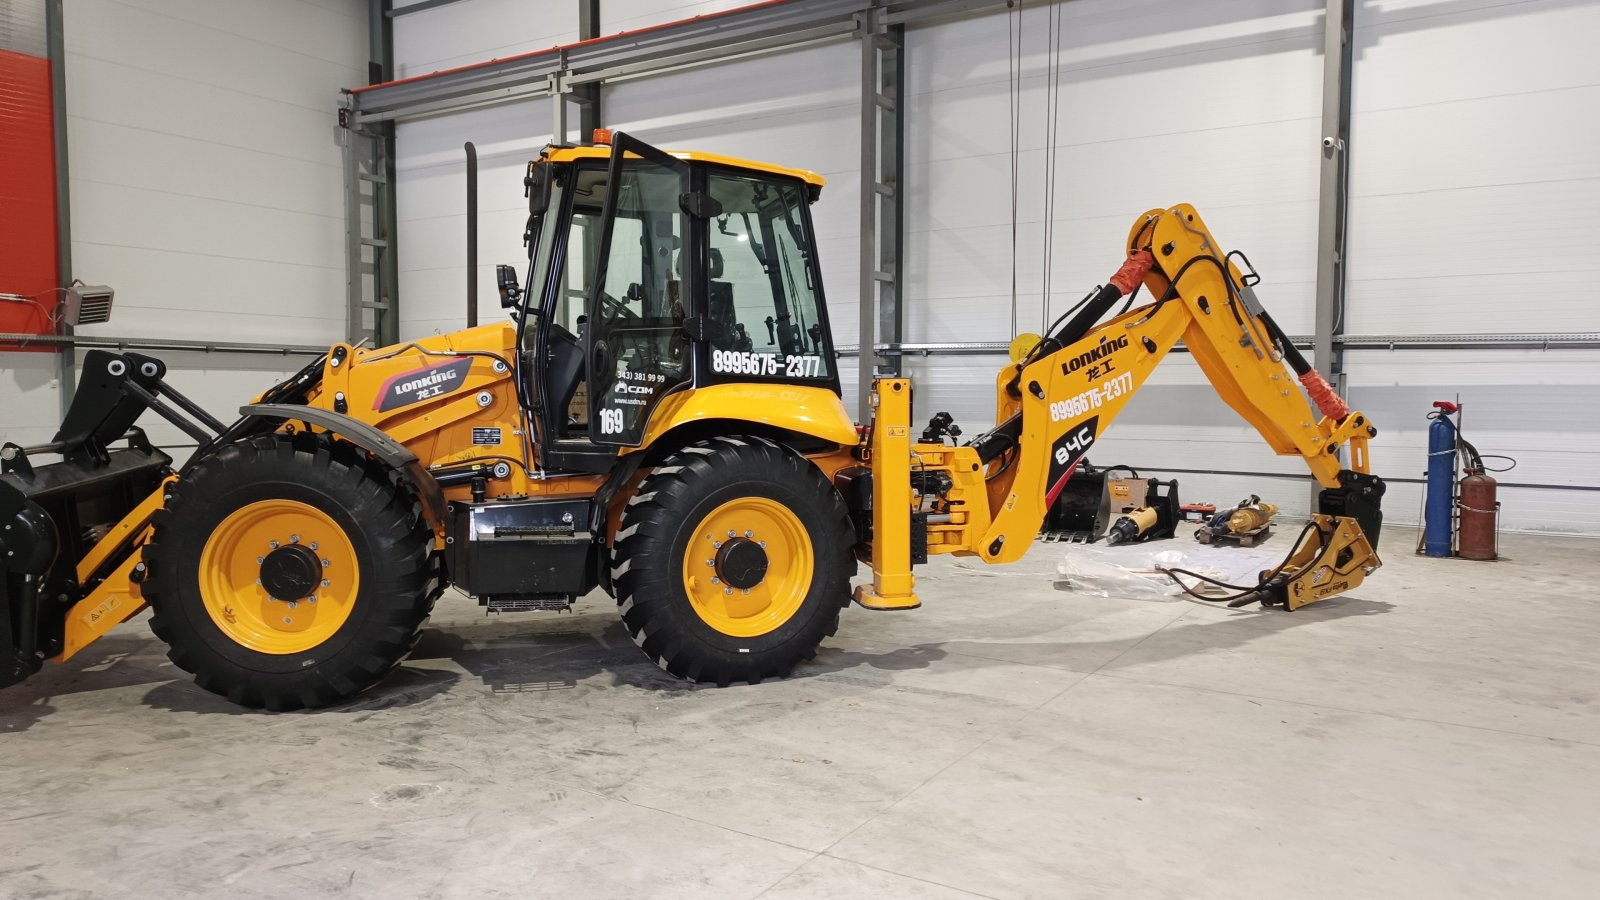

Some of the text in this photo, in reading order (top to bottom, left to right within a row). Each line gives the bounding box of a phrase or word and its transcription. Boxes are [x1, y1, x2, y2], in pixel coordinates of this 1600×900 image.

[713, 349, 820, 378] 8995675-2377
[1086, 358, 1115, 382] 龙工
[634, 373, 646, 381] 381
[648, 374, 656, 382] 99
[657, 375, 665, 383] 99
[416, 385, 444, 400] 龙工
[1050, 371, 1133, 422] 8995675-2377
[599, 408, 624, 435] 169
[1055, 427, 1093, 465] 84C
